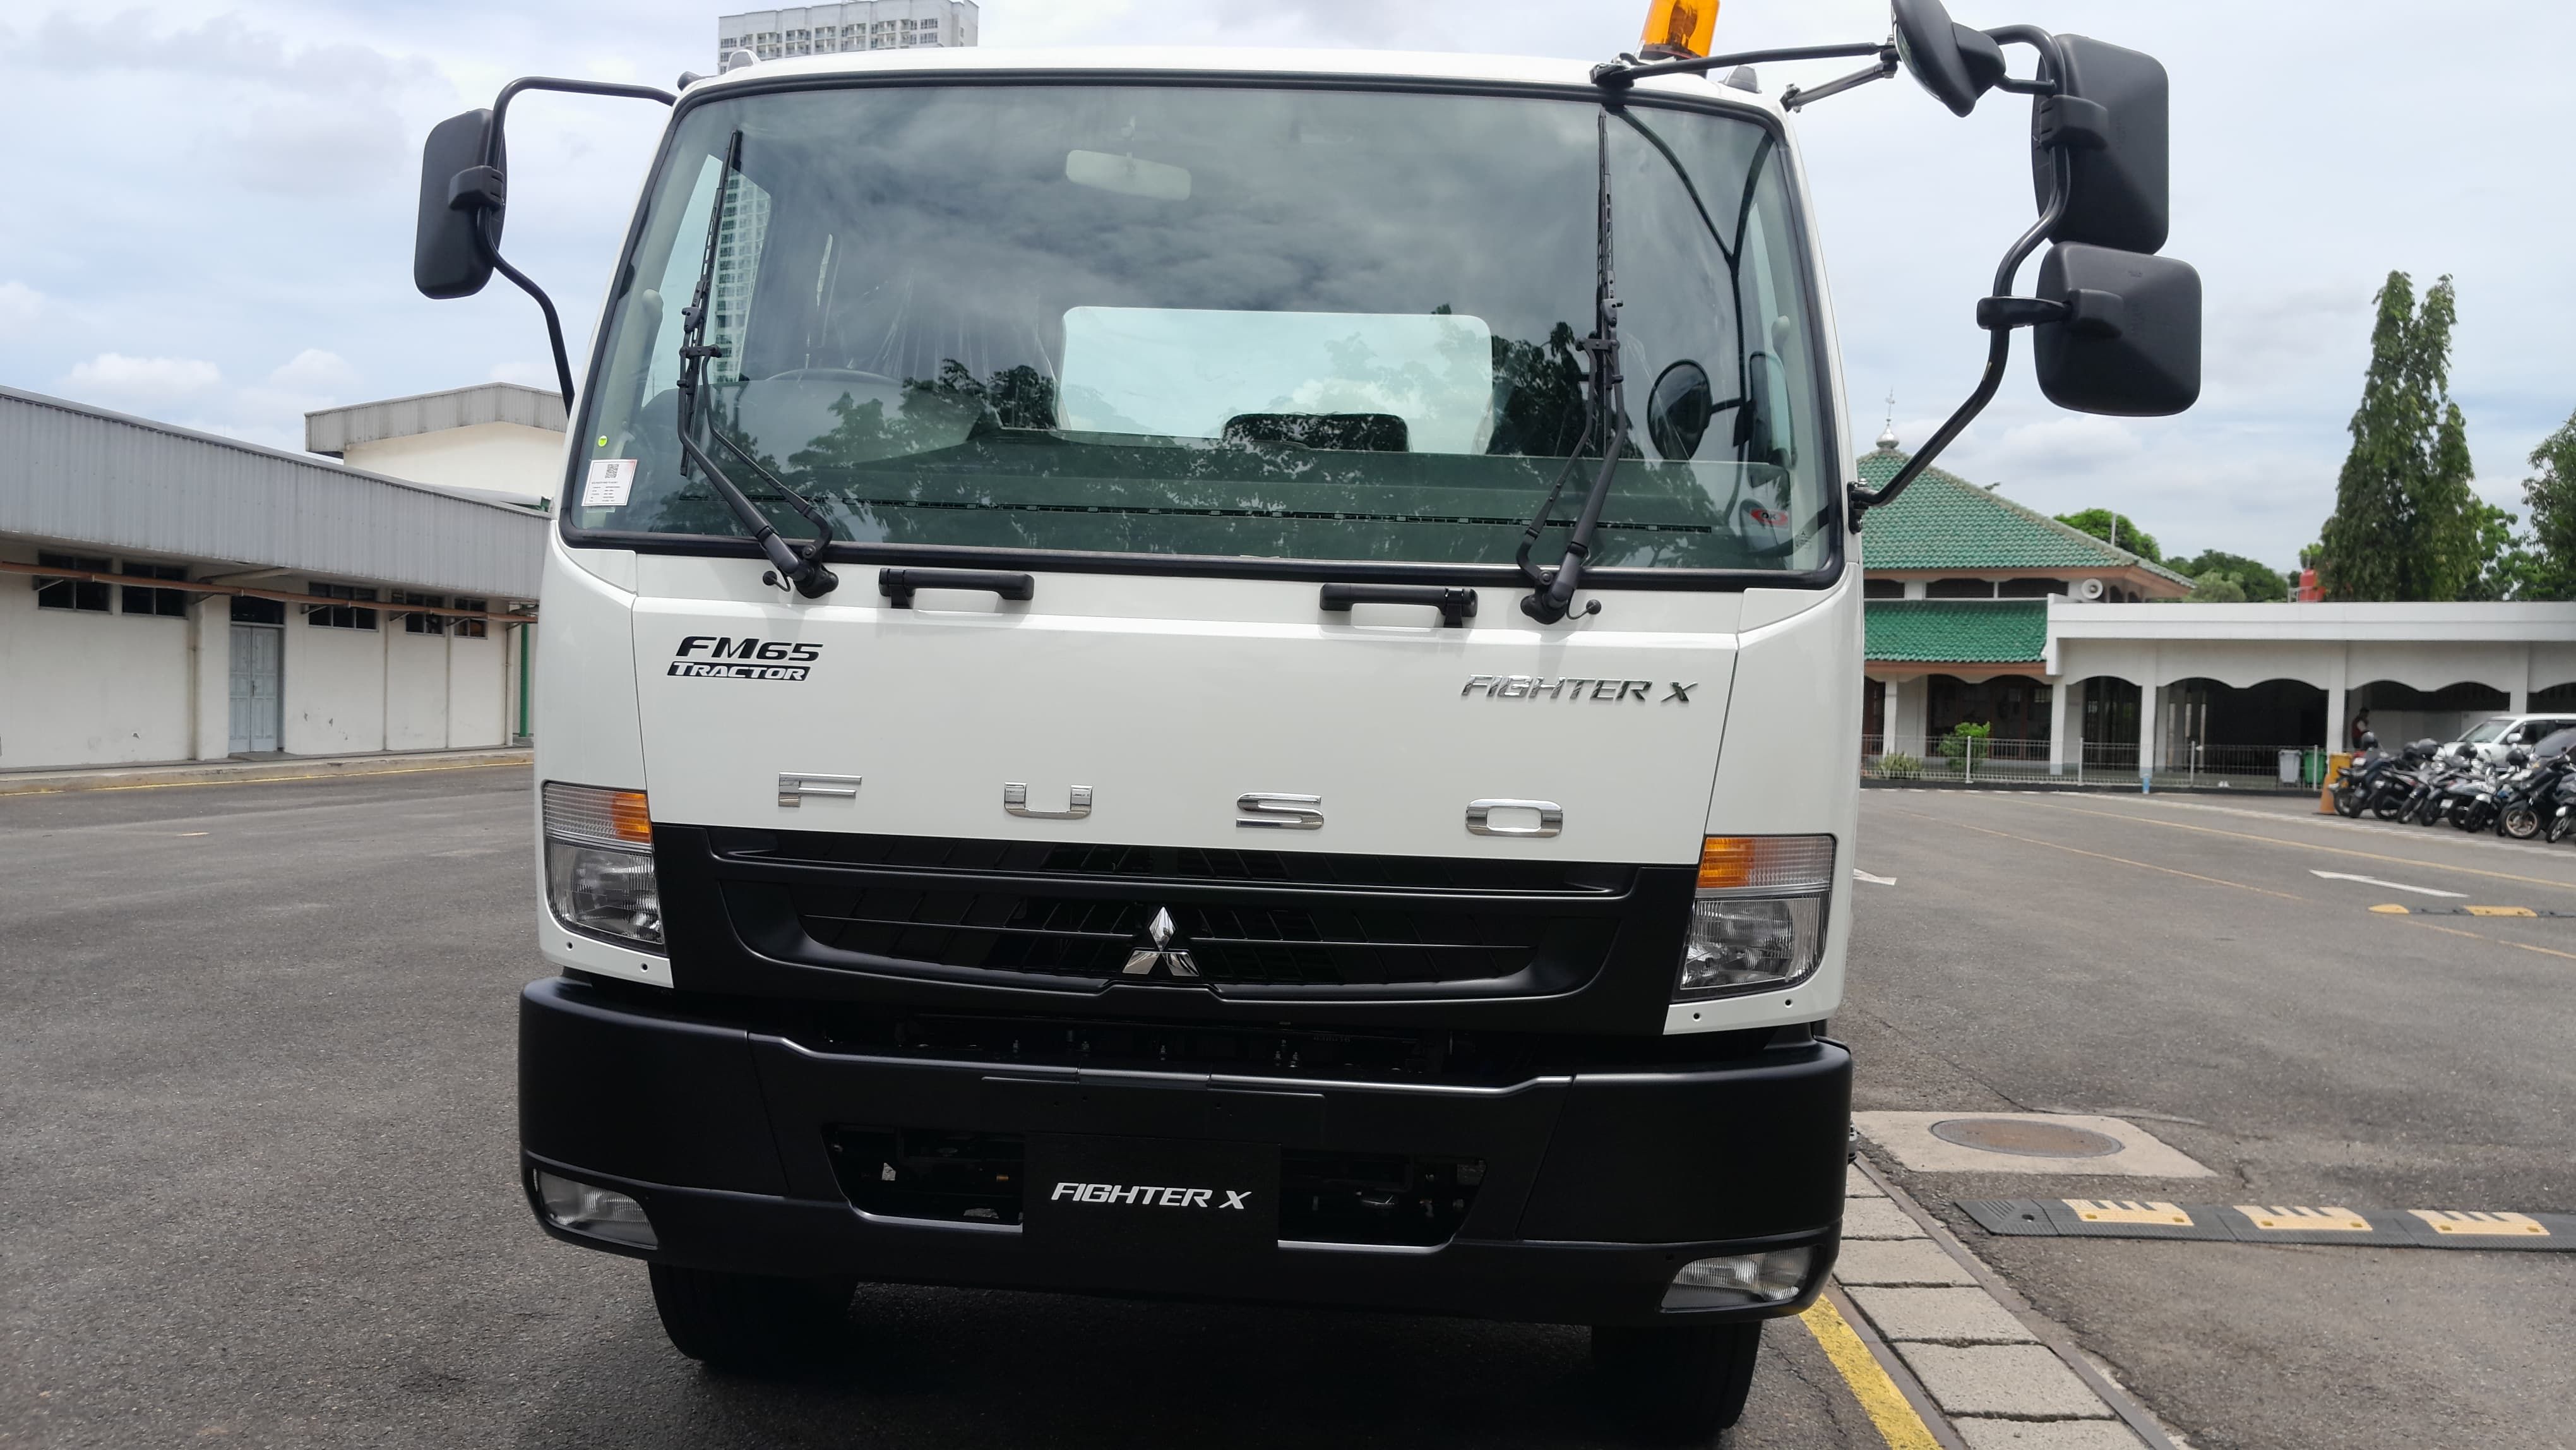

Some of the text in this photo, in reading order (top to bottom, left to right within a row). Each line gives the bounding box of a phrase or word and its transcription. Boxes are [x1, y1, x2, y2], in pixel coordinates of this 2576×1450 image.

[1761, 512, 1777, 520] OK
[675, 635, 824, 662] FM65
[672, 662, 806, 681] TRACTOR
[1460, 673, 1698, 702] FIGHTER X
[778, 771, 1563, 838] FUSO
[1051, 1182, 1253, 1210] FIGHTER X
